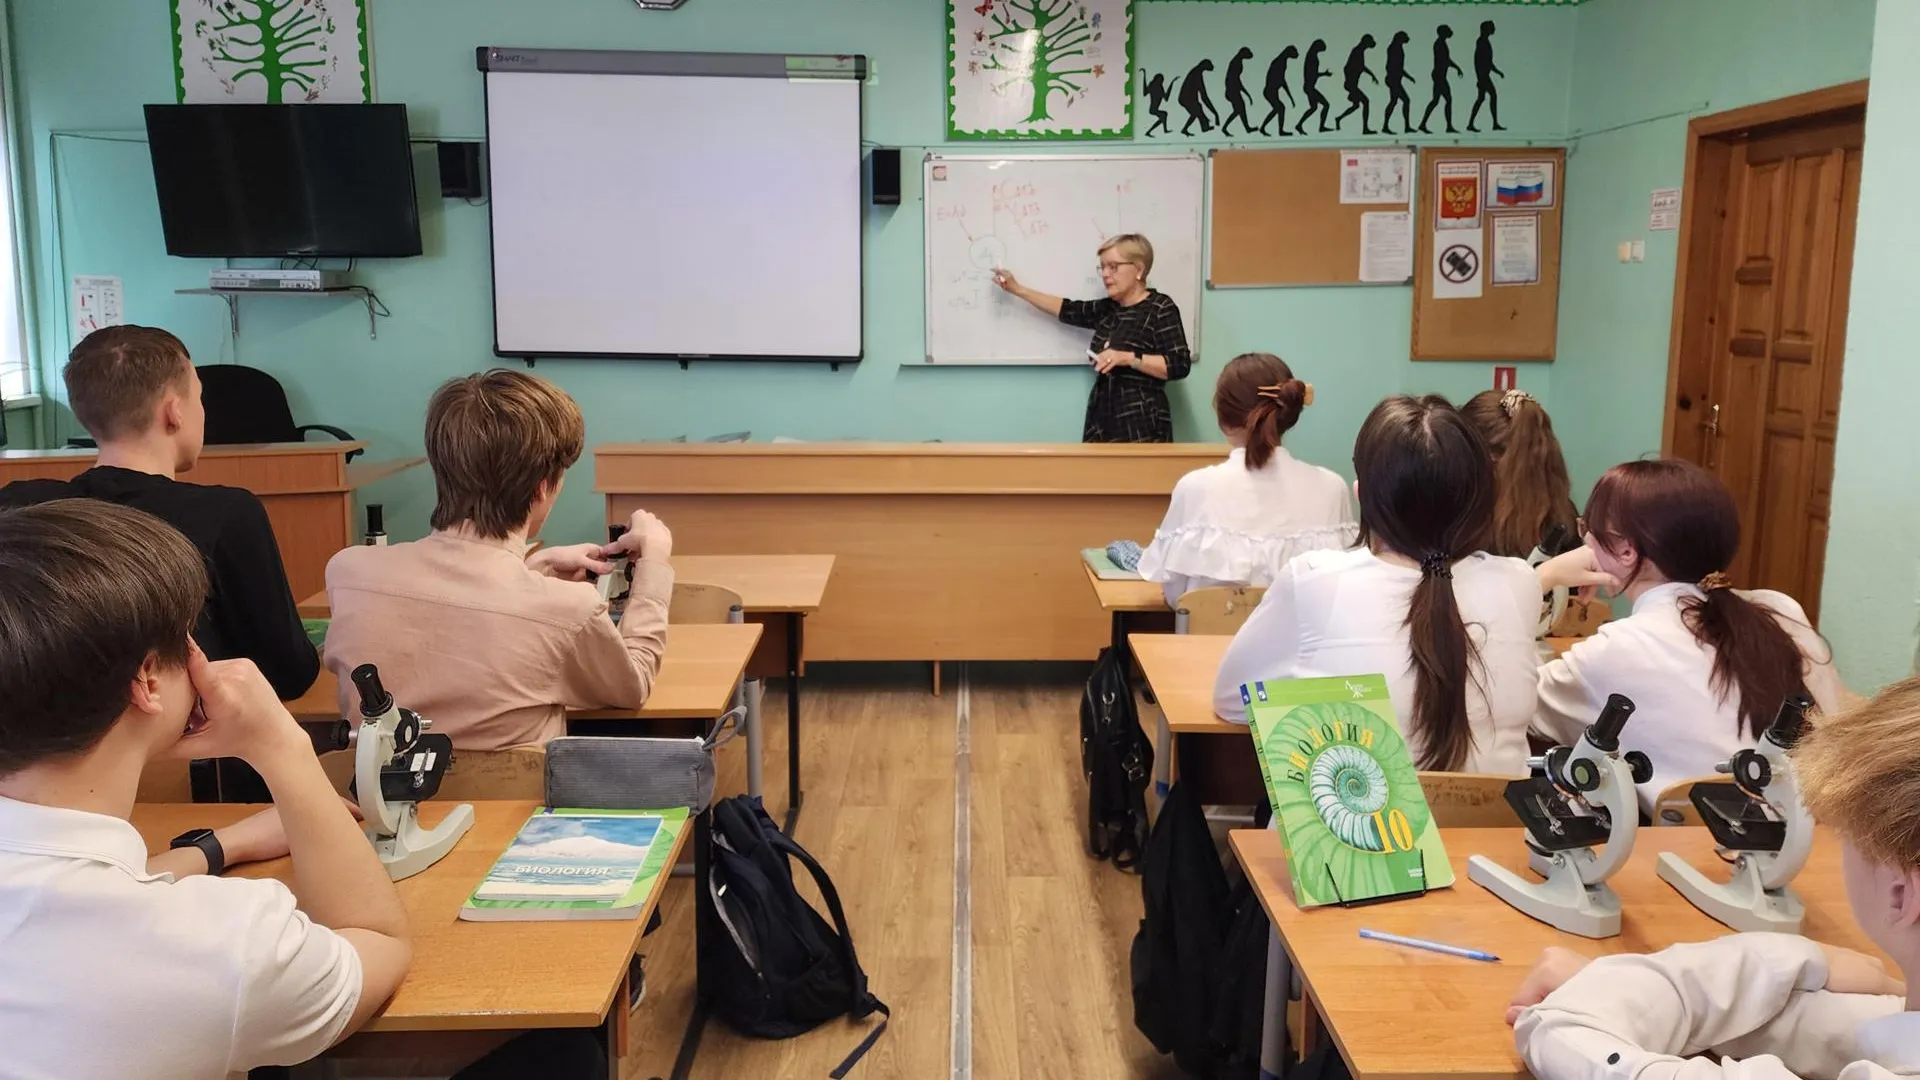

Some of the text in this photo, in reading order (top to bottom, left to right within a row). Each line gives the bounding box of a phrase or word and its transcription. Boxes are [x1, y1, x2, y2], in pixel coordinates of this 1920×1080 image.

[1287, 721, 1374, 784] БИОЛОГИЯ
[1371, 809, 1413, 853] 10
[515, 865, 610, 876] БИОЛОГИЯ
